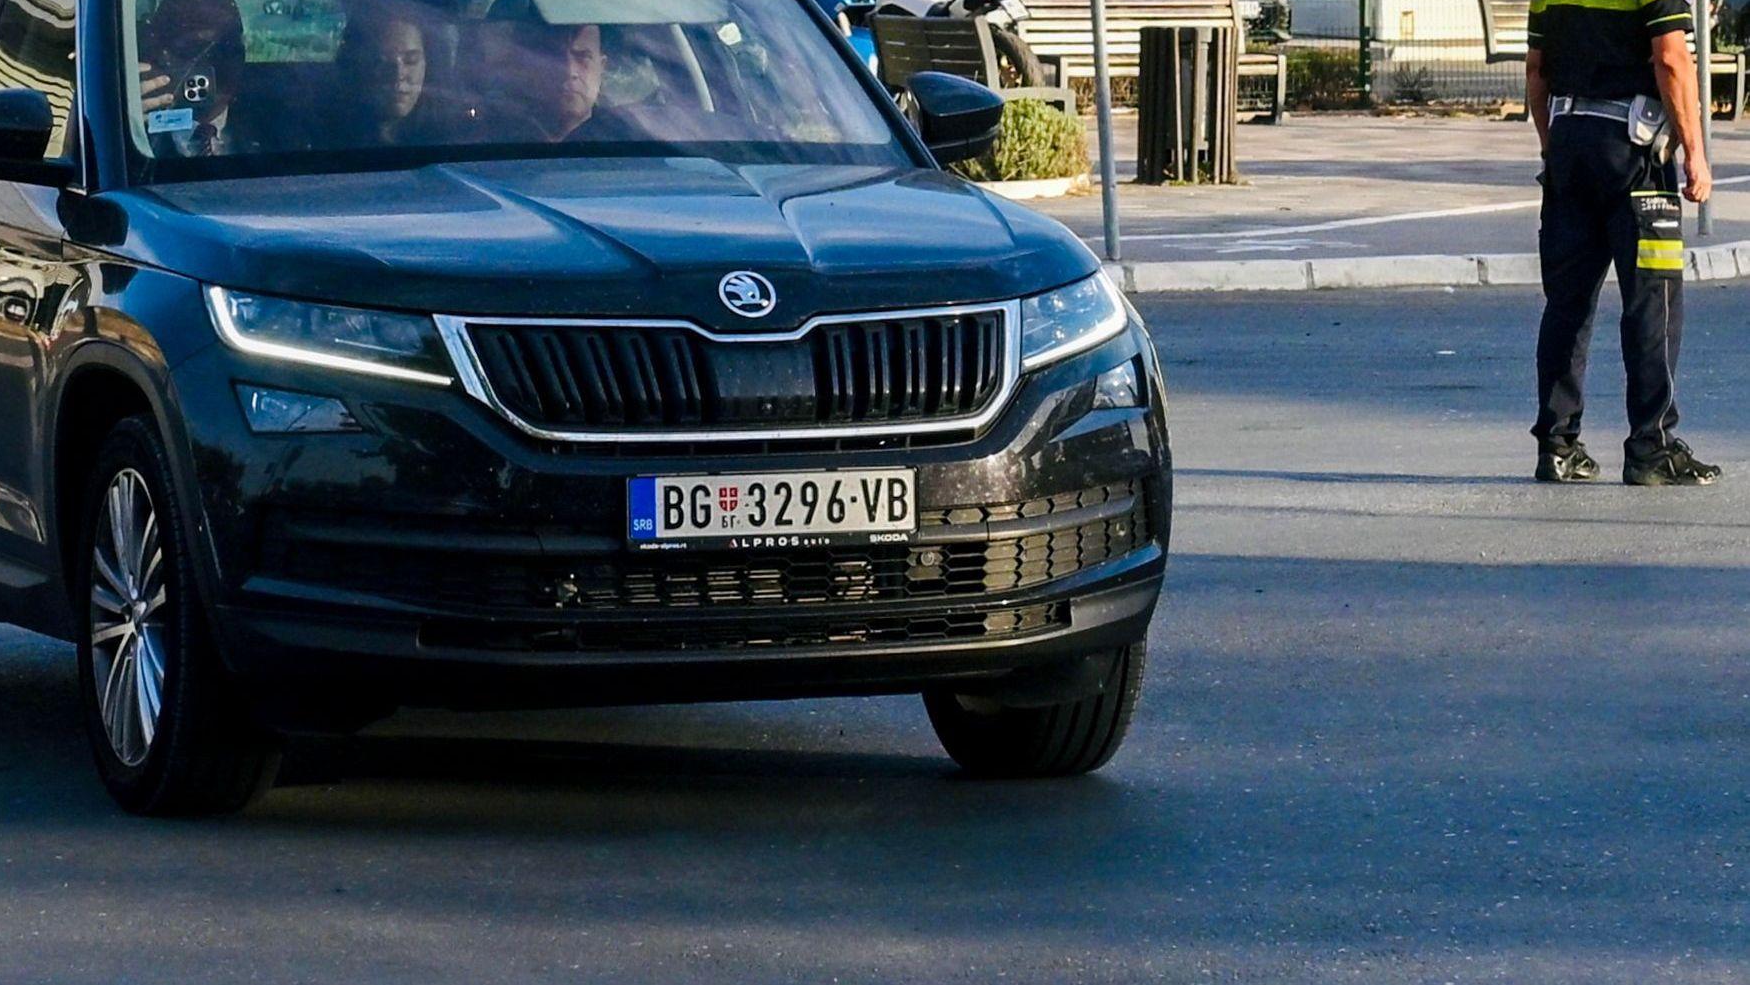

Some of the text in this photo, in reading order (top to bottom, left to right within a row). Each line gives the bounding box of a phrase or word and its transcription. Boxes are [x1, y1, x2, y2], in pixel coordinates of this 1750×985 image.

[663, 484, 712, 530] BG
[633, 518, 653, 531] SRB
[730, 536, 799, 548] ALPROS
